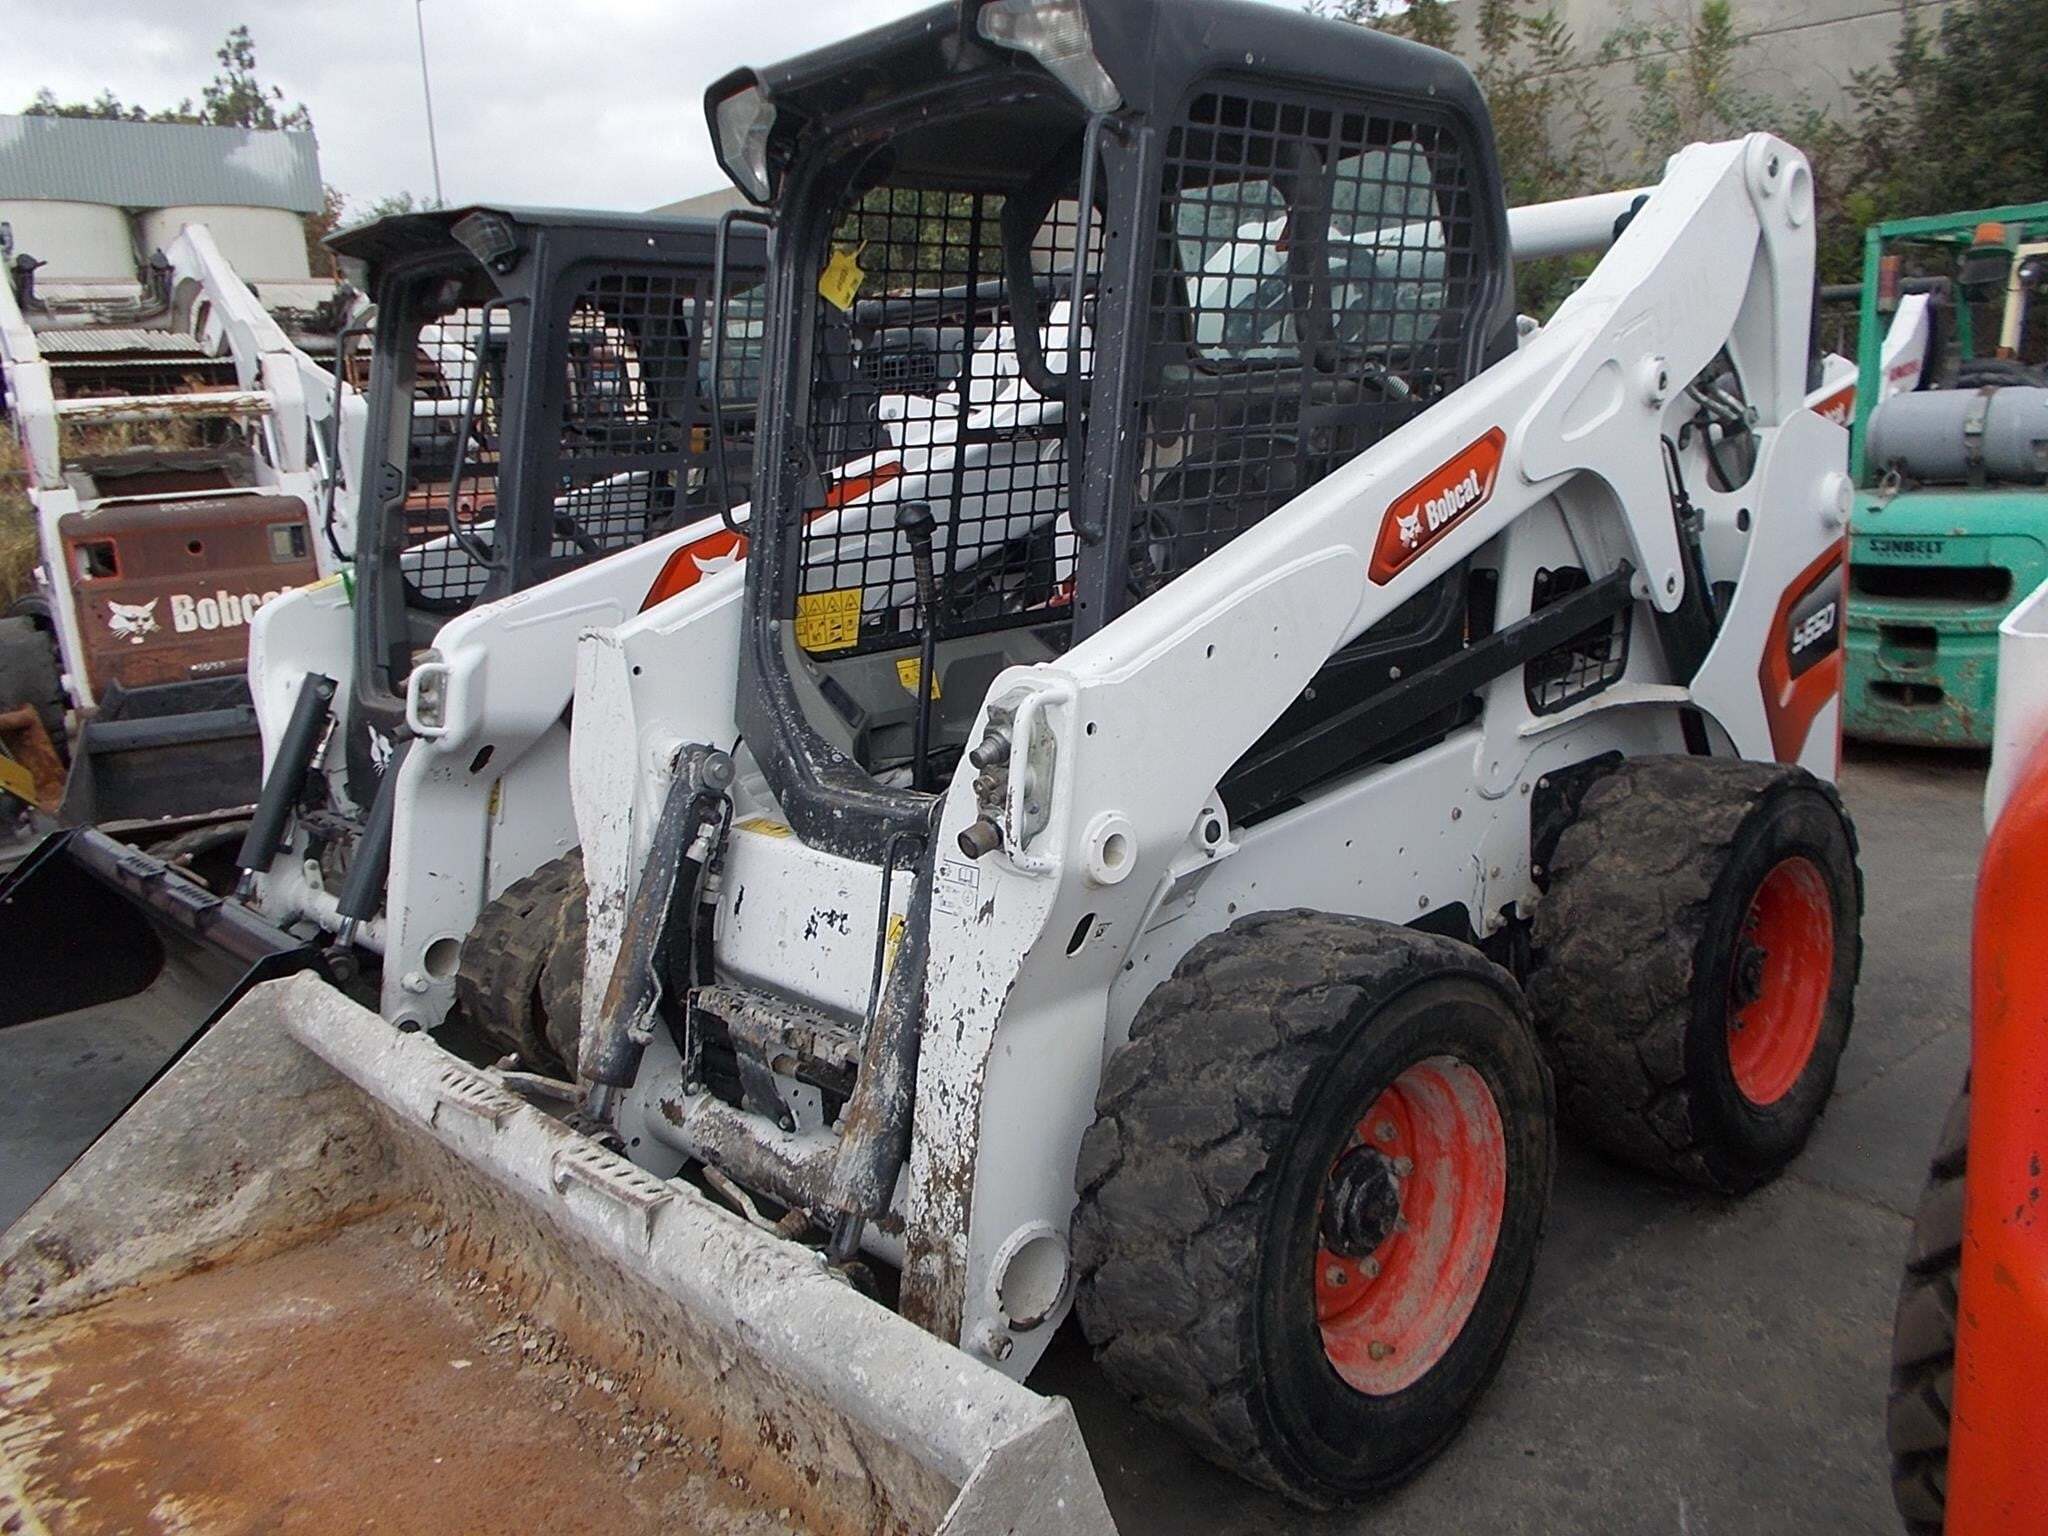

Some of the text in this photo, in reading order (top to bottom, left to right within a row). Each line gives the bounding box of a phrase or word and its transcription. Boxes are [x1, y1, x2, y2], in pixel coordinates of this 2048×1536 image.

[1425, 468, 1480, 531] Bobcat
[170, 585, 292, 633] Bobc
[1791, 602, 1836, 655] S650
